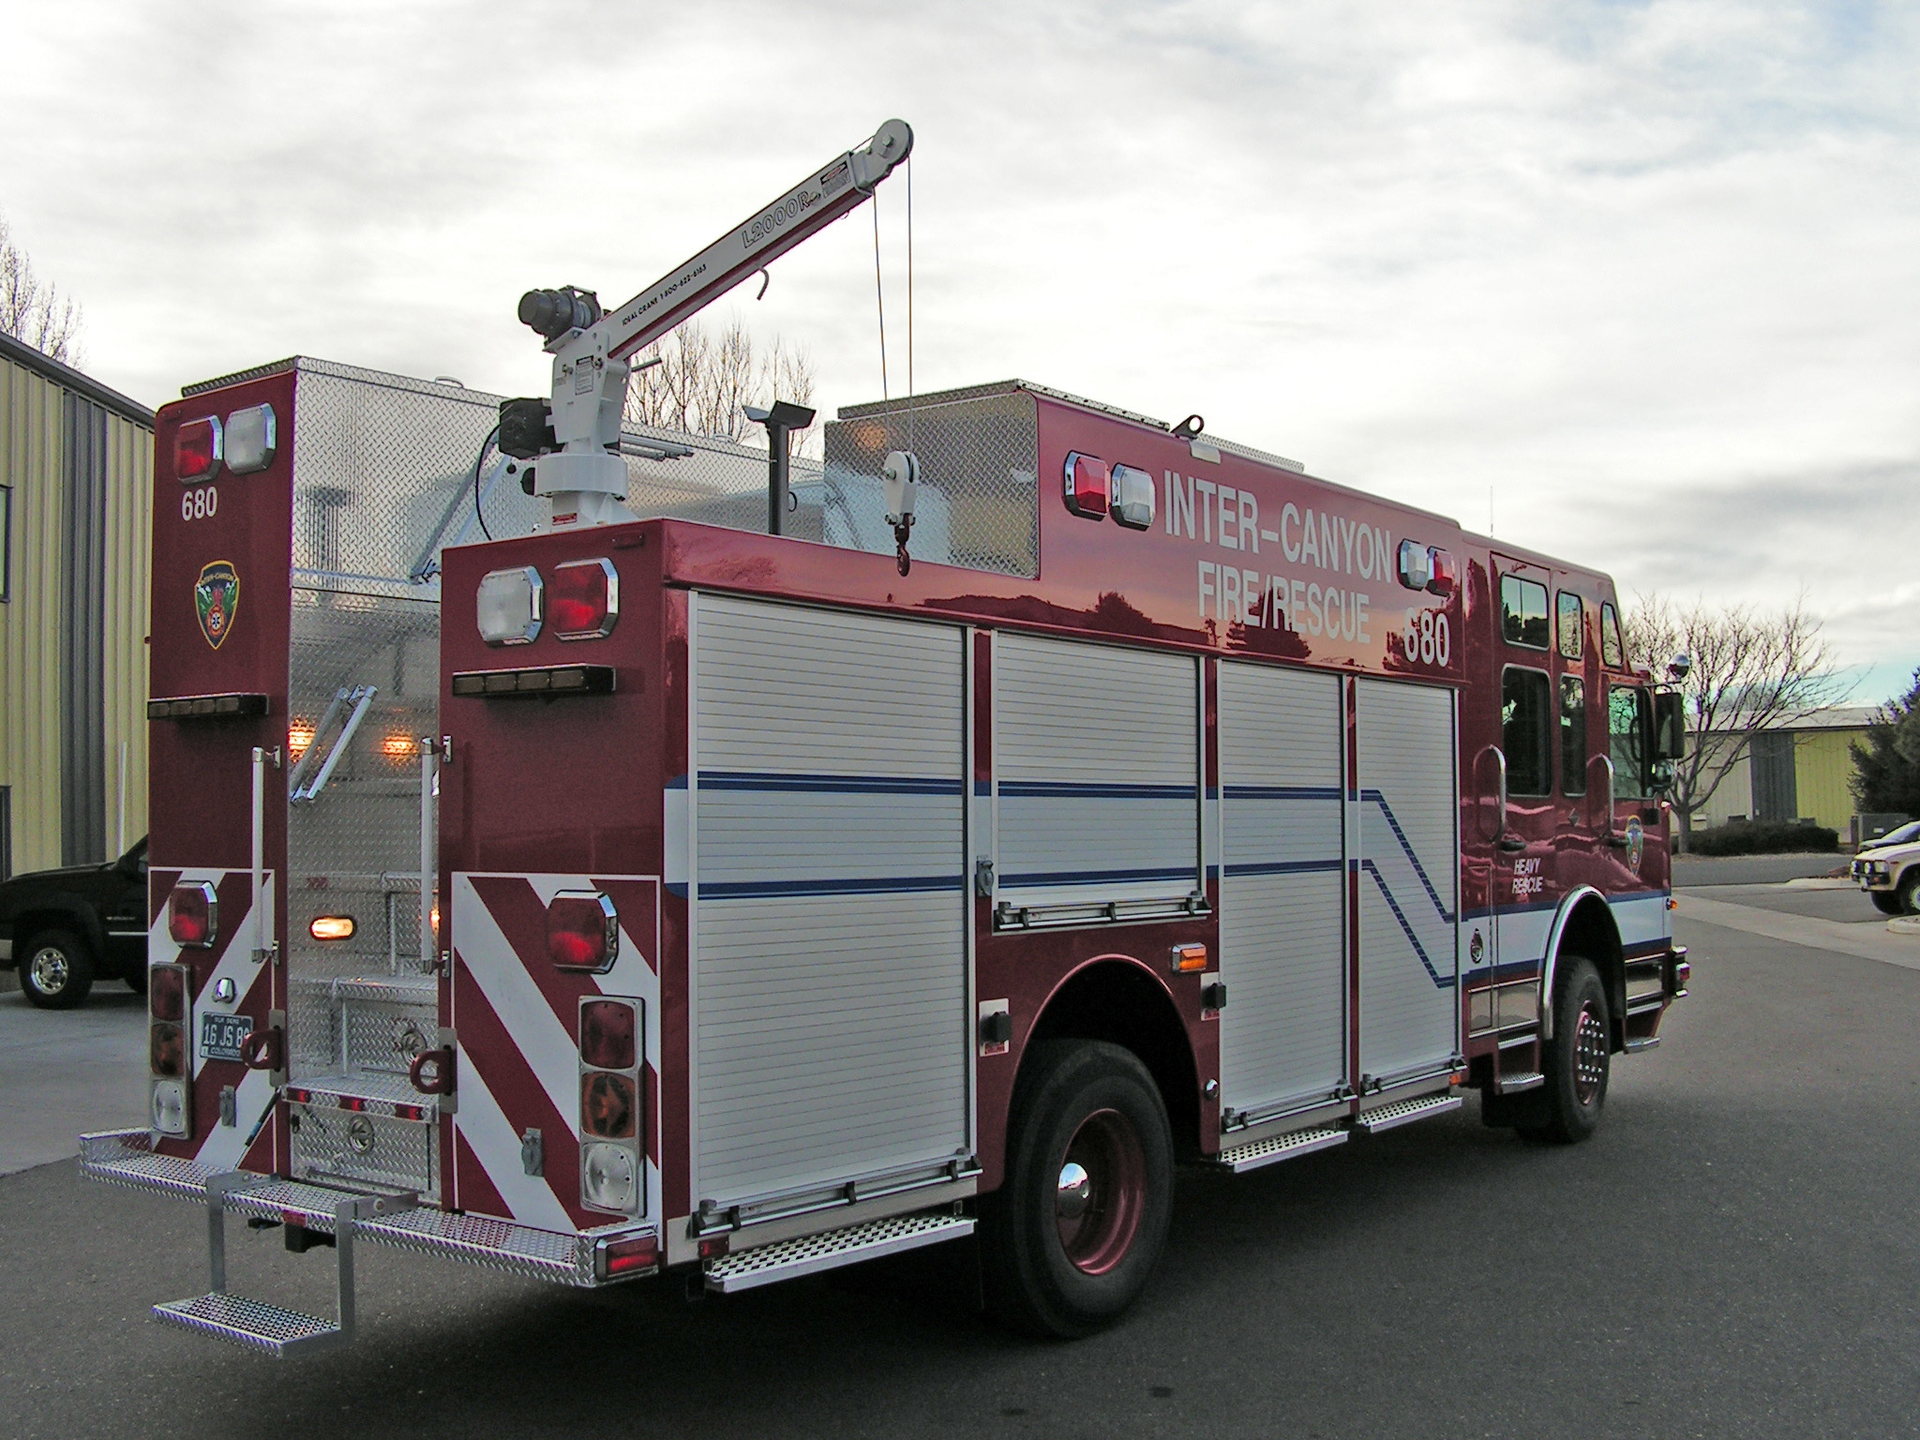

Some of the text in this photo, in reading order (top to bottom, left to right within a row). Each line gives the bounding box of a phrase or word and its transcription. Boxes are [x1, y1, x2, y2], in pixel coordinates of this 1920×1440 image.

[741, 190, 811, 249] L2000R
[181, 486, 218, 522] 680
[1164, 469, 1392, 584] INTER-CANYON
[1197, 559, 1371, 645] FIRE/RESCUE
[1403, 607, 1451, 668] 680
[1513, 857, 1541, 875] HEAVY
[1511, 876, 1544, 894] RESCUE
[203, 1023, 217, 1046] 16
[219, 1025, 234, 1047] JS
[210, 1047, 241, 1057] COLORADO
